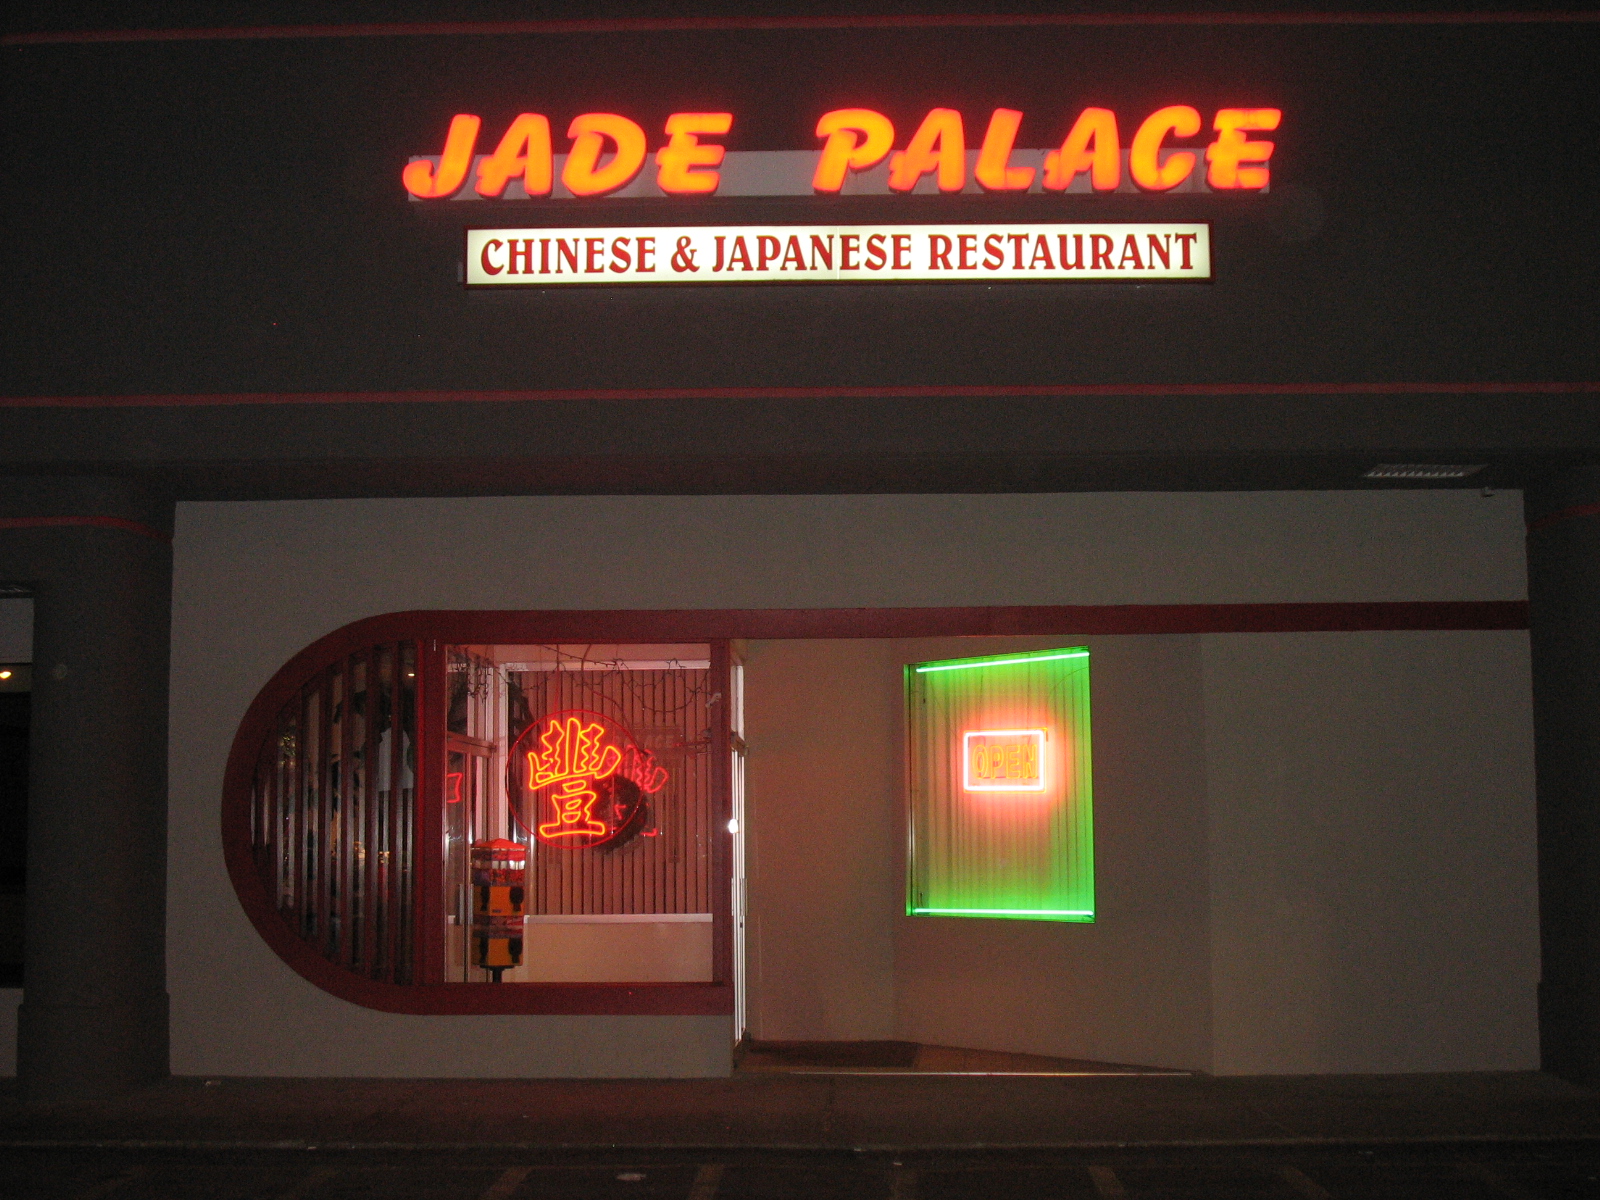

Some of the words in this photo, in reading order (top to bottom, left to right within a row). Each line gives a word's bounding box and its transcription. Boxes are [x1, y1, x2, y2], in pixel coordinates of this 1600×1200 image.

[402, 112, 733, 199] JADE
[811, 105, 1282, 192] PALACE
[480, 236, 656, 276] CHINESE
[670, 235, 701, 273] &
[711, 232, 912, 272] JAPANESE
[928, 231, 1198, 271] RESTAURANT
[971, 743, 1038, 780] OPEN
